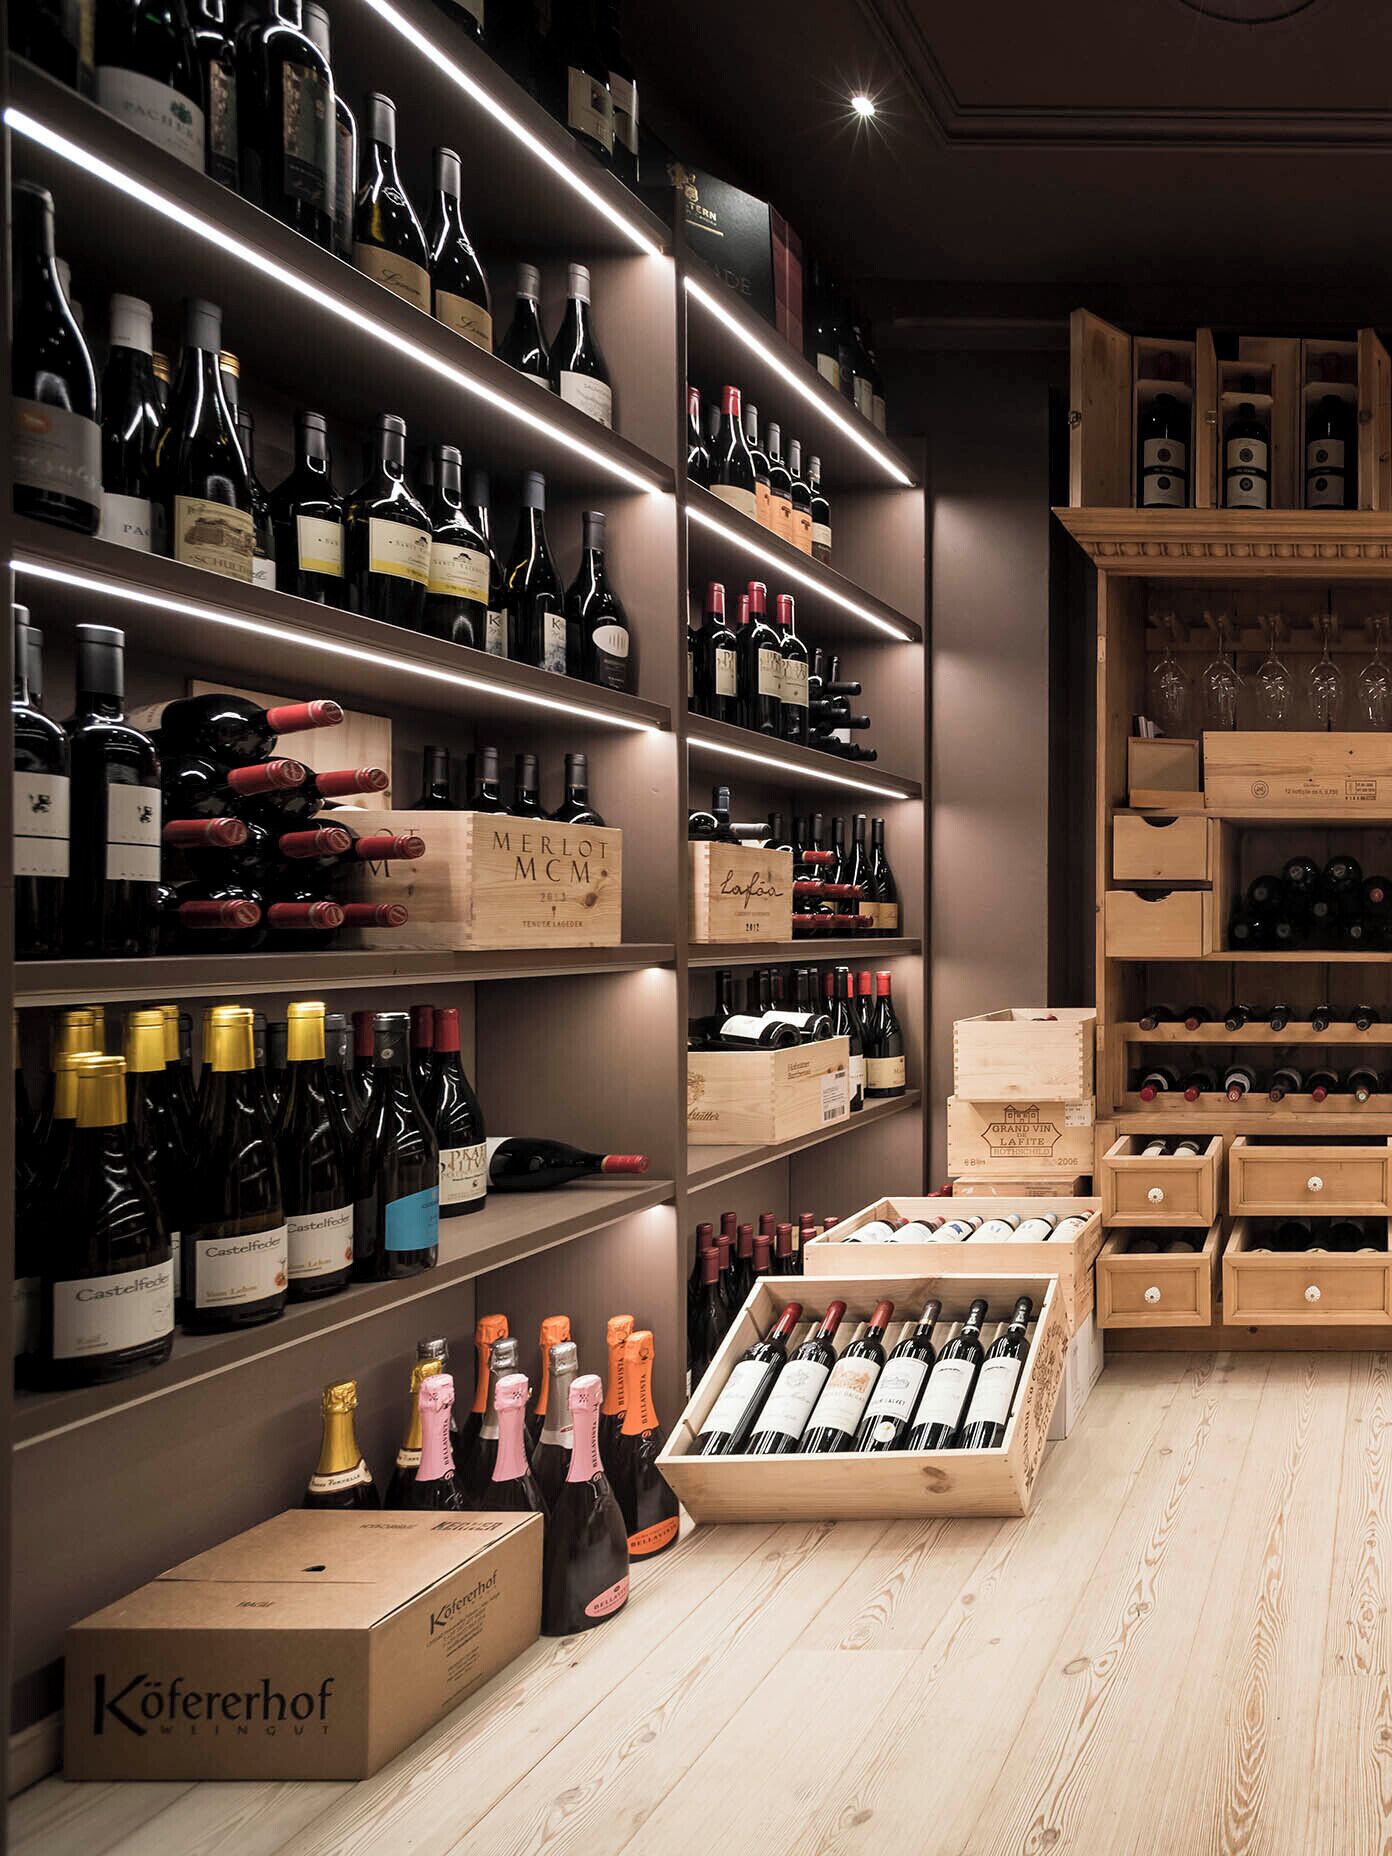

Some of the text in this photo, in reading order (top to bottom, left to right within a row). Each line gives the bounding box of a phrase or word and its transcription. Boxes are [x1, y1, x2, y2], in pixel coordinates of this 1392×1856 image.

[686, 202, 717, 222] TERN
[491, 831, 609, 860] MERLOT
[513, 856, 591, 884] MCM
[745, 922, 761, 933] 2012
[992, 1124, 1051, 1133] GRAND VIN
[1000, 1138, 1045, 1146] LAFITE
[1057, 1158, 1078, 1166] 2006
[287, 1214, 353, 1235] Castelfeder
[204, 1236, 283, 1259] Castelfeder
[75, 1272, 171, 1303] Castelfeder
[617, 1357, 625, 1406] BELLAVISTA
[640, 1373, 648, 1425] BELLAVISTA
[630, 1524, 678, 1549] BELLAVISTA
[430, 1568, 499, 1636] Köfererhof
[93, 1673, 336, 1737] Köfererhof
[160, 1725, 329, 1738] WEINGUT
